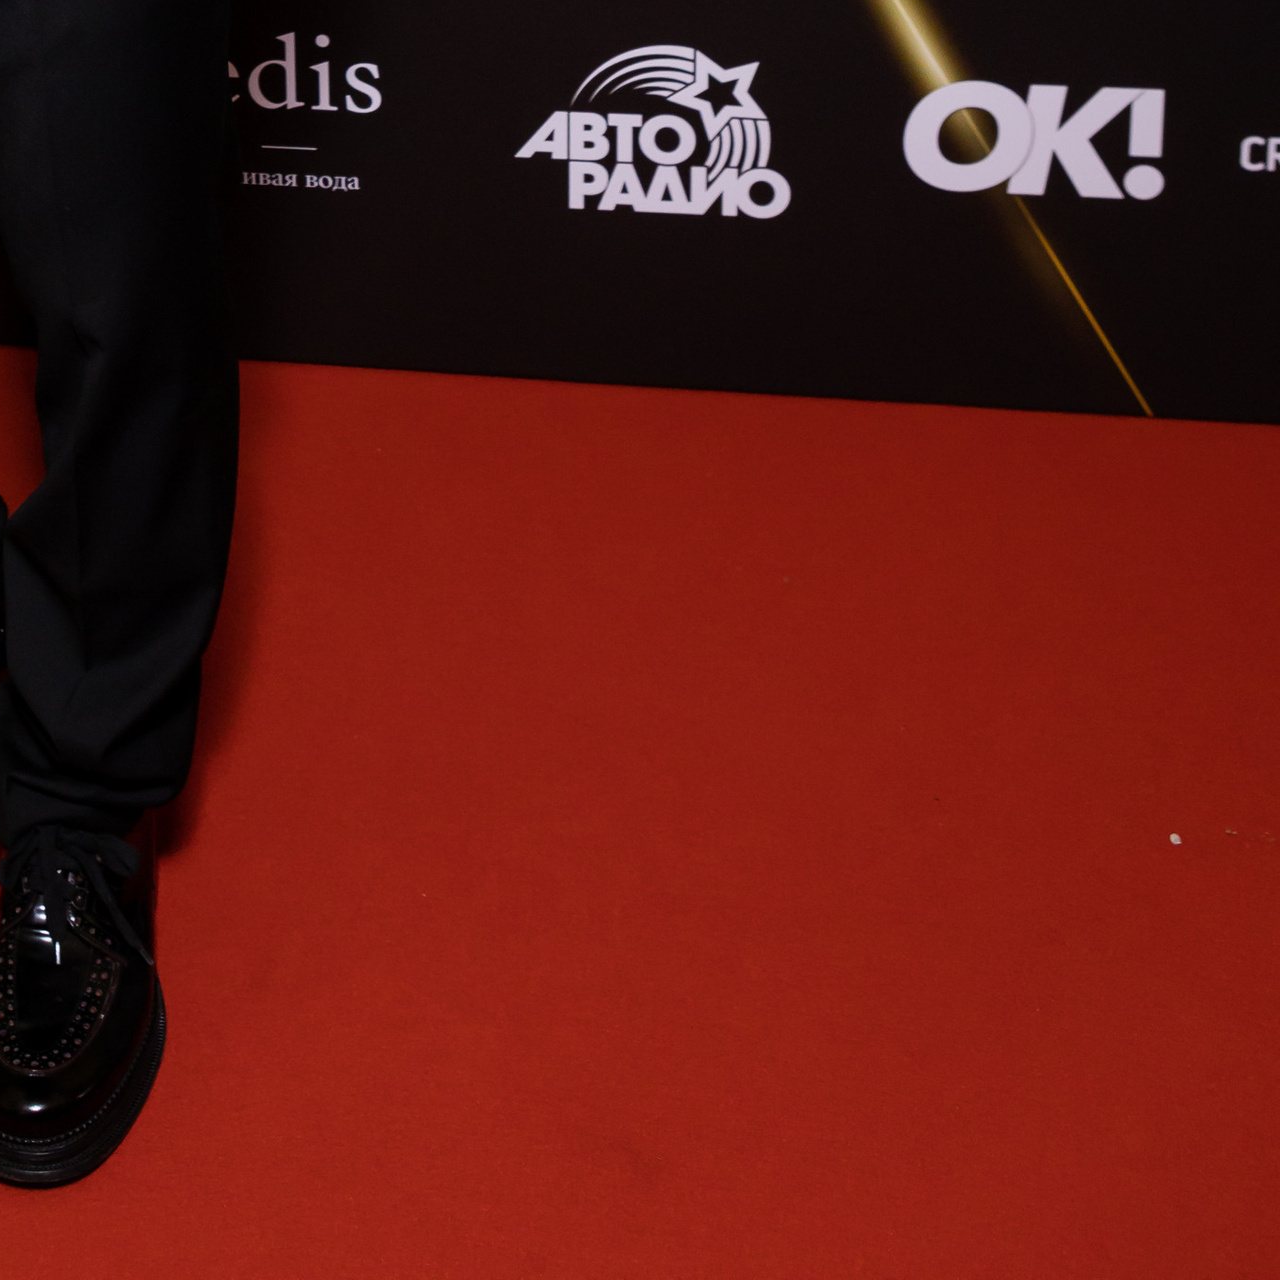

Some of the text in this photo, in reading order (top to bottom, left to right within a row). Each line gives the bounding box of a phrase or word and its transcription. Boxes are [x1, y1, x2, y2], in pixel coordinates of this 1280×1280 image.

[228, 32, 382, 114] dis
[514, 110, 697, 166] АВТО
[904, 80, 1165, 200] OK!
[304, 174, 361, 192] вода
[568, 161, 792, 219] РАДИО
